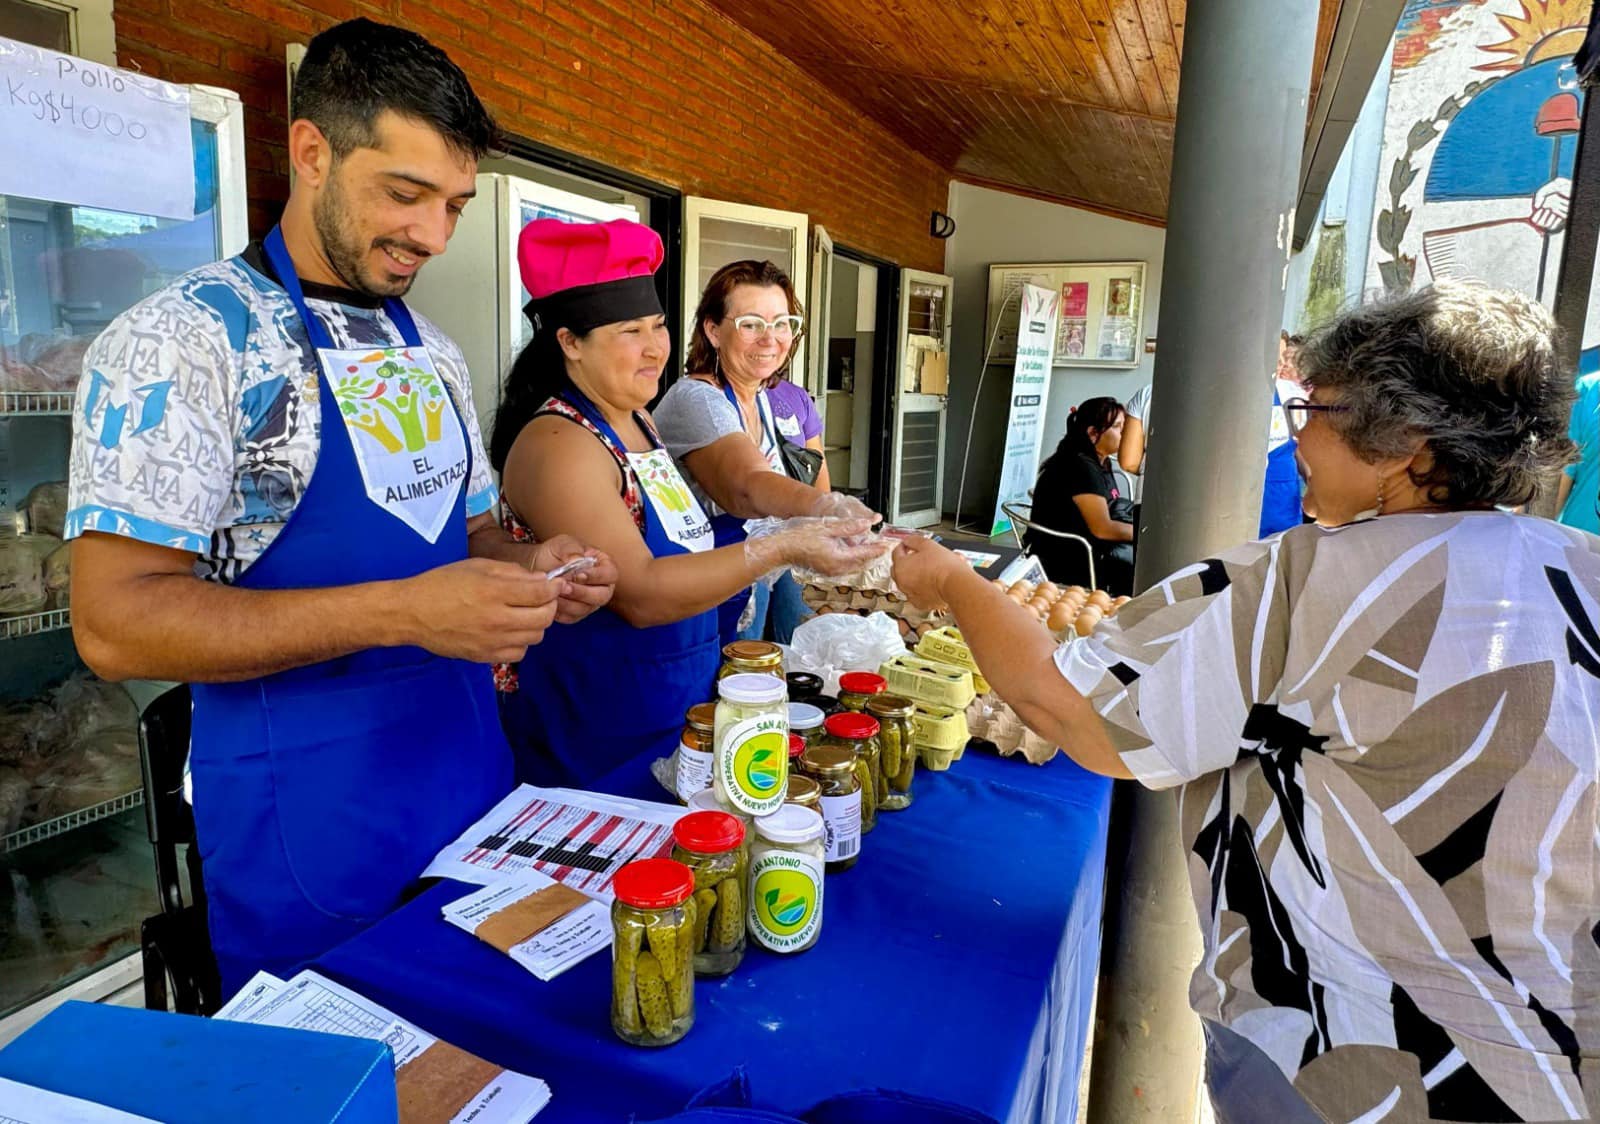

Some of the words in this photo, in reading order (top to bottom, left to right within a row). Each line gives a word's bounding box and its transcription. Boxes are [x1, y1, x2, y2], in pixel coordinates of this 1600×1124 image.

[55, 56, 125, 93] Pollo
[110, 329, 164, 382] AFA
[125, 451, 184, 509] AFA
[413, 456, 435, 474] EL
[683, 515, 696, 525] EL
[756, 720, 774, 731] SAN
[724, 750, 743, 801] COOPERATIVA
[742, 798, 768, 811] NUEVO
[763, 855, 801, 869] ANTONIO
[750, 908, 790, 947] COOPERATIVA
[791, 926, 813, 945] NUEVO
